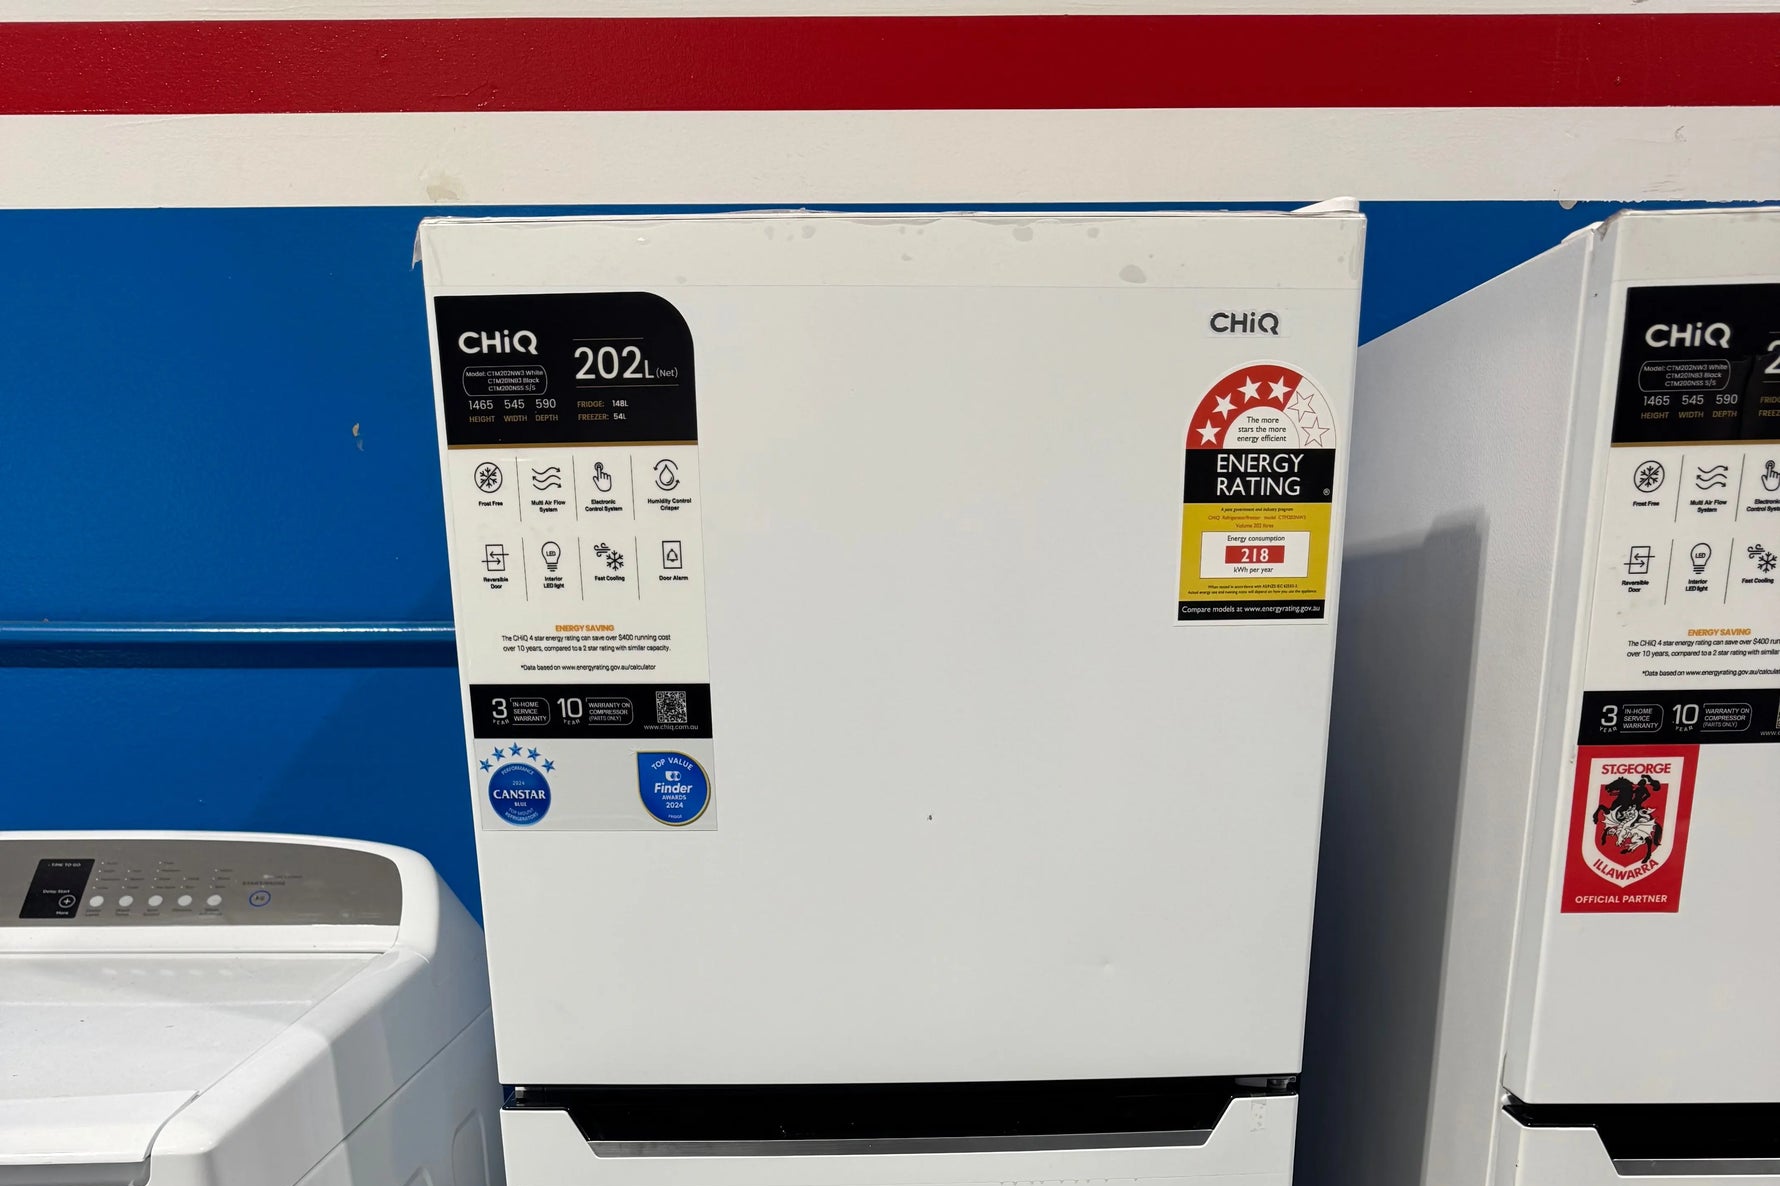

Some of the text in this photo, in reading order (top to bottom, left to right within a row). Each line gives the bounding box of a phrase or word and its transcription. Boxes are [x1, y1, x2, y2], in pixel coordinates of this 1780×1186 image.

[1210, 311, 1279, 335] CHiQ
[1645, 322, 1731, 348] CHiQ
[458, 329, 538, 355] CHiQ
[574, 345, 678, 379] 202L (Net)
[525, 384, 536, 392] S/S
[1704, 379, 1716, 387] S/S
[468, 398, 557, 410] 1465 545 590
[577, 400, 605, 408] FRIDGE:
[1643, 394, 1738, 406] 1465 545 590
[1640, 411, 1669, 419] HEIGHT
[1712, 410, 1737, 418] DEPTH
[1216, 453, 1304, 473] ENERGY
[1216, 477, 1300, 496] RATING
[1241, 548, 1269, 562] 218
[1181, 605, 1211, 614] Compare
[1243, 605, 1320, 613] www.energyrating.gov.au
[634, 634, 657, 642] running
[1720, 628, 1751, 636] SAVING
[492, 698, 507, 718] 3
[557, 698, 582, 718] 10
[1673, 704, 1699, 724] 10
[1601, 705, 1618, 726] 3
[651, 757, 694, 771] TOP VALUE
[1601, 763, 1672, 774] ST.GEORGE
[493, 789, 546, 799] CANSTAR
[654, 782, 693, 793] Finder
[1592, 858, 1659, 881] ILLAWARRA
[1575, 895, 1668, 904] OFFICIAL PARTNER
